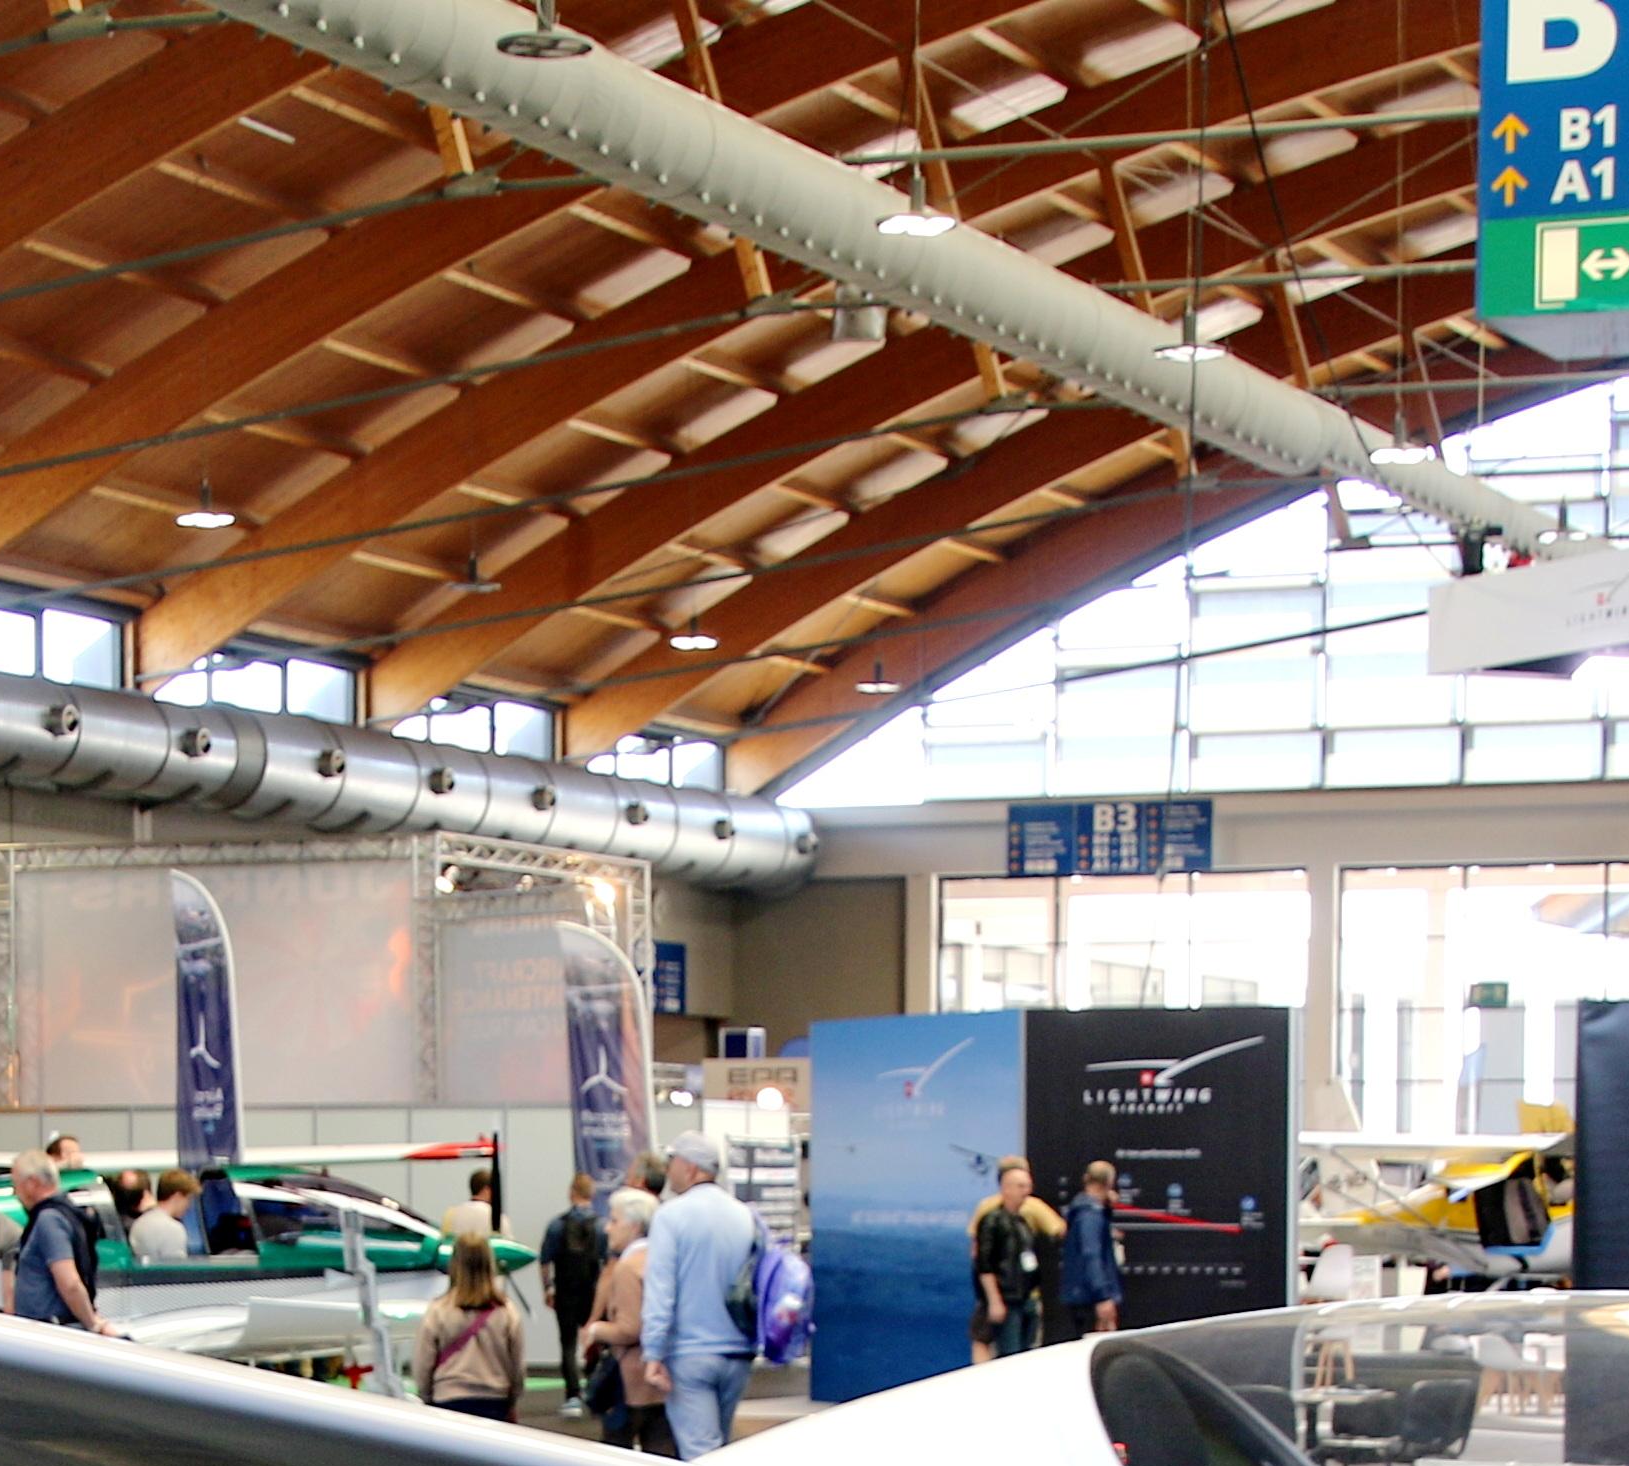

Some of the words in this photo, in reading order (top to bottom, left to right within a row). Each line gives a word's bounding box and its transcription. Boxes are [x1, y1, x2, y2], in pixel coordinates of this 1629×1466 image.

[1560, 104, 1617, 151] B1
[1550, 156, 1615, 204] A1
[1093, 803, 1136, 832] B3
[1082, 1087, 1212, 1105] LIGHTWING
